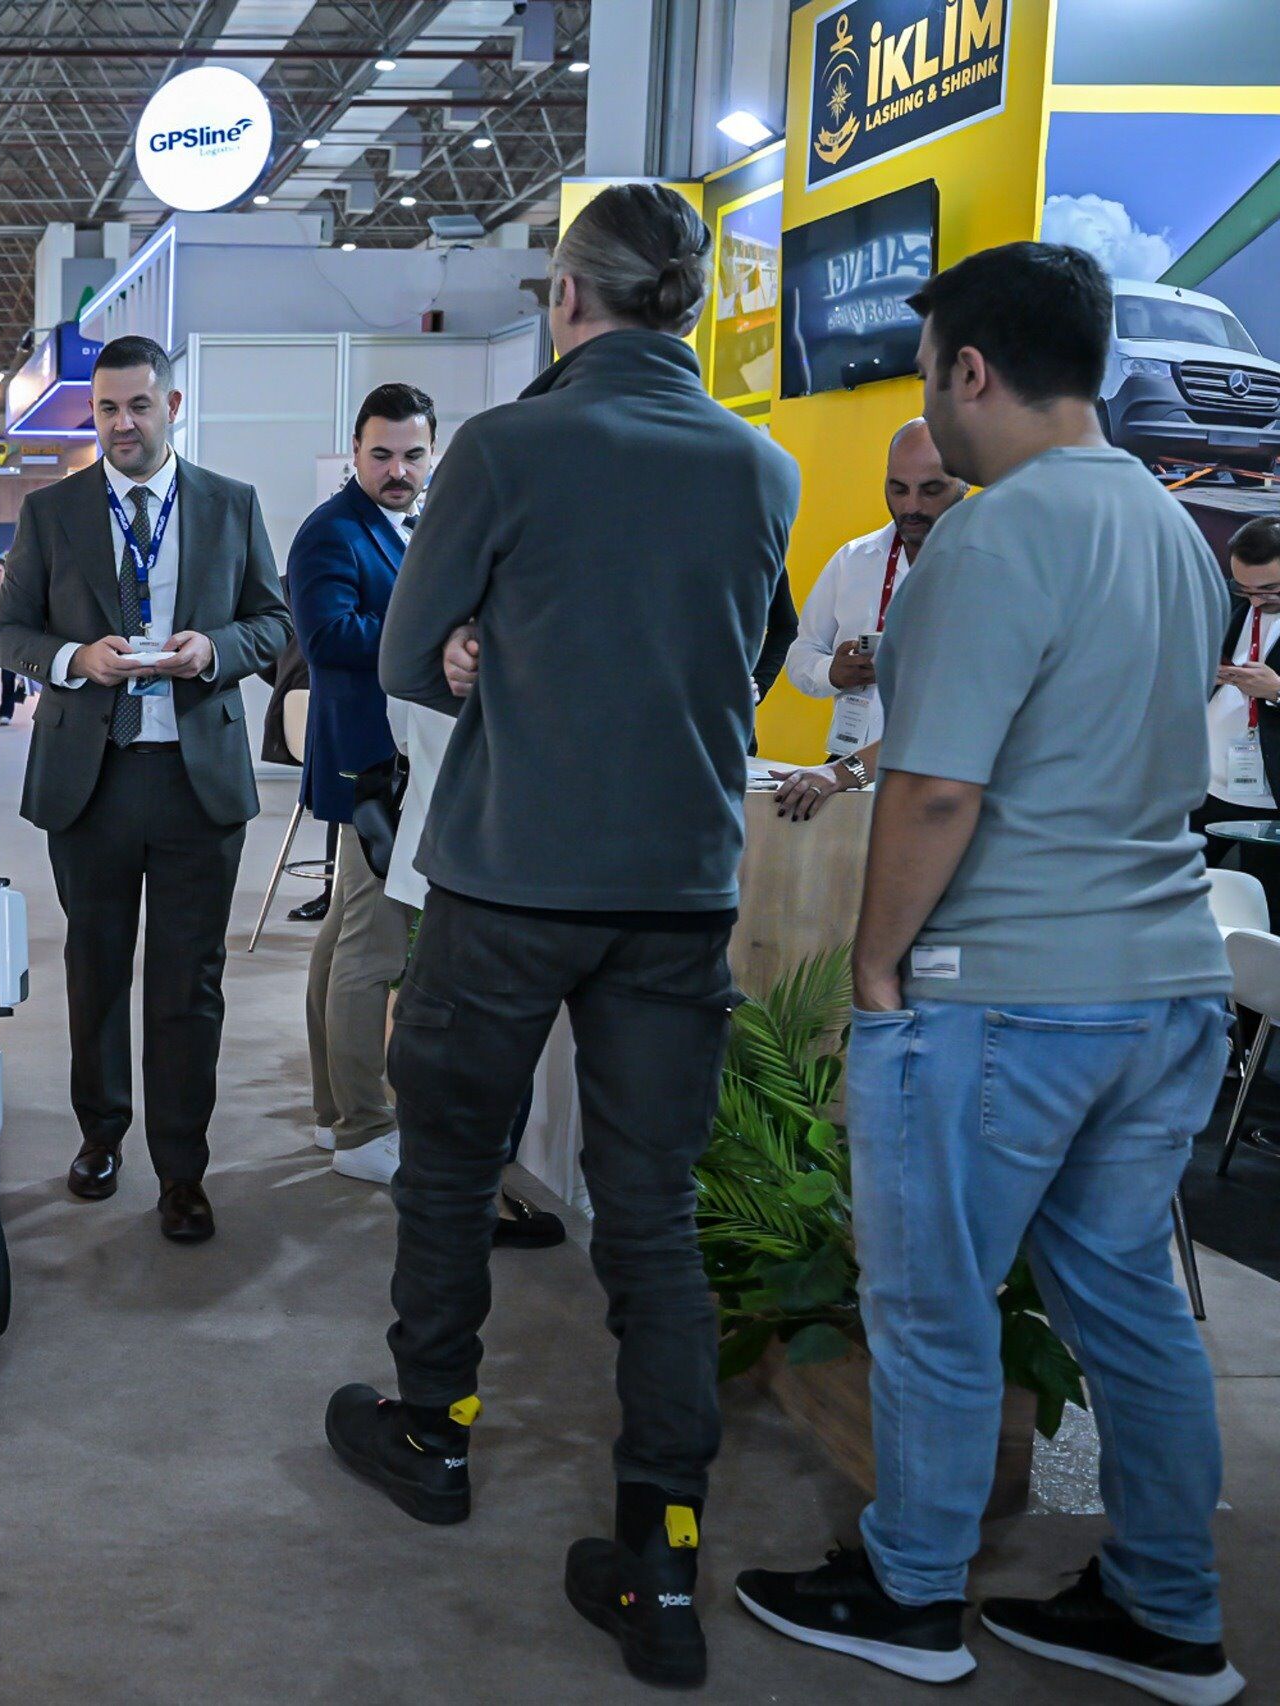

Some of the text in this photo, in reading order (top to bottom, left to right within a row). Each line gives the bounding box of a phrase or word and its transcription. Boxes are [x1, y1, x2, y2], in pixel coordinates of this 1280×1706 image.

[867, 0, 1003, 107] İKLİM
[865, 55, 999, 132] LASHING & SHRINK
[149, 126, 242, 153] GPSline
